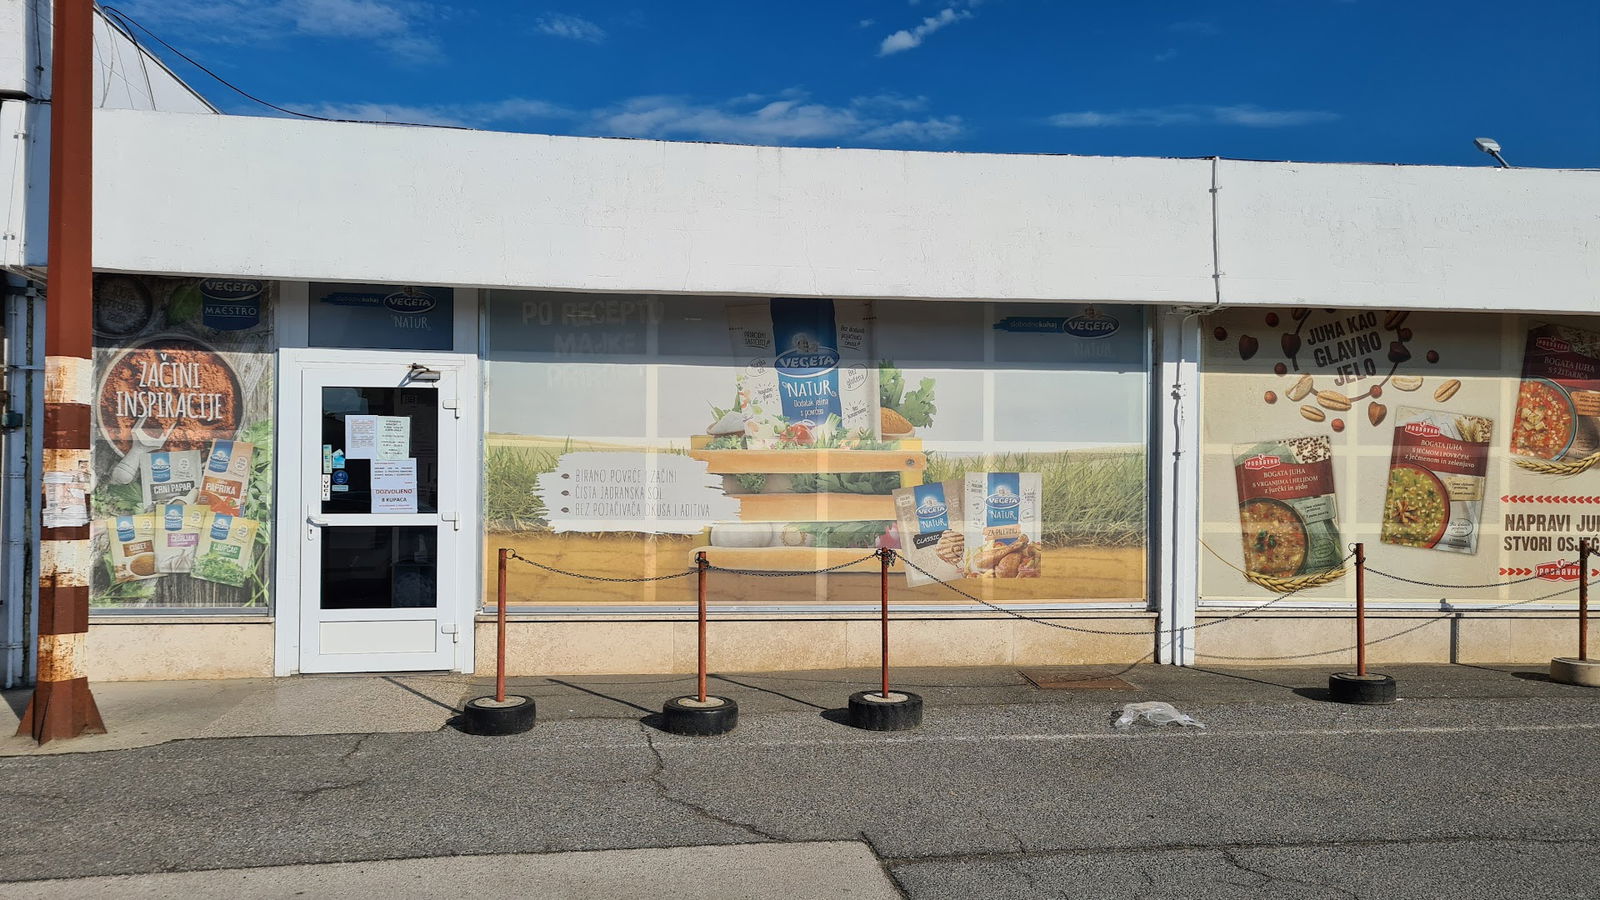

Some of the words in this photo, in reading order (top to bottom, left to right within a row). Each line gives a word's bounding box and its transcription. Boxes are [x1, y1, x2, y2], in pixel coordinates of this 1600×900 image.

[205, 281, 258, 293] VEGETA
[389, 297, 431, 307] VEGETA
[205, 305, 257, 316] MAESTRO
[394, 315, 428, 329] NATUR
[1069, 321, 1115, 331] VEGETA
[1307, 322, 1345, 346] JUHA
[1347, 311, 1377, 332] KAO
[1313, 331, 1382, 368] GLAVNO
[780, 355, 834, 368] VEGETA
[1544, 356, 1574, 369] BOGATA
[1575, 361, 1595, 373] JUHA
[139, 353, 201, 389] ZAČINI
[1334, 358, 1376, 387] JELO
[787, 380, 832, 397] NATUR
[115, 391, 224, 421] INSPIRACIJE
[1421, 440, 1445, 449] BOGATA
[1446, 443, 1463, 451] JUHA
[575, 469, 606, 483] BIRANO
[651, 467, 677, 483] ZAČINI
[1263, 470, 1288, 478] BOGATA
[1289, 468, 1306, 476] JUHA
[171, 481, 192, 492] PAPAR
[205, 483, 236, 495] PAPRIKA
[575, 485, 596, 499] ČISTA
[601, 487, 645, 500] JADRANSKA
[575, 503, 589, 516] BEZ
[593, 501, 641, 516] POJAČIVAČA
[681, 503, 710, 517] ADITIVA
[990, 510, 1014, 520] NATUR
[921, 518, 945, 528] NATUR
[1505, 514, 1571, 532] NAPRAVI
[1504, 536, 1552, 552] STVORI
[1540, 567, 1580, 576] PODRAVK
